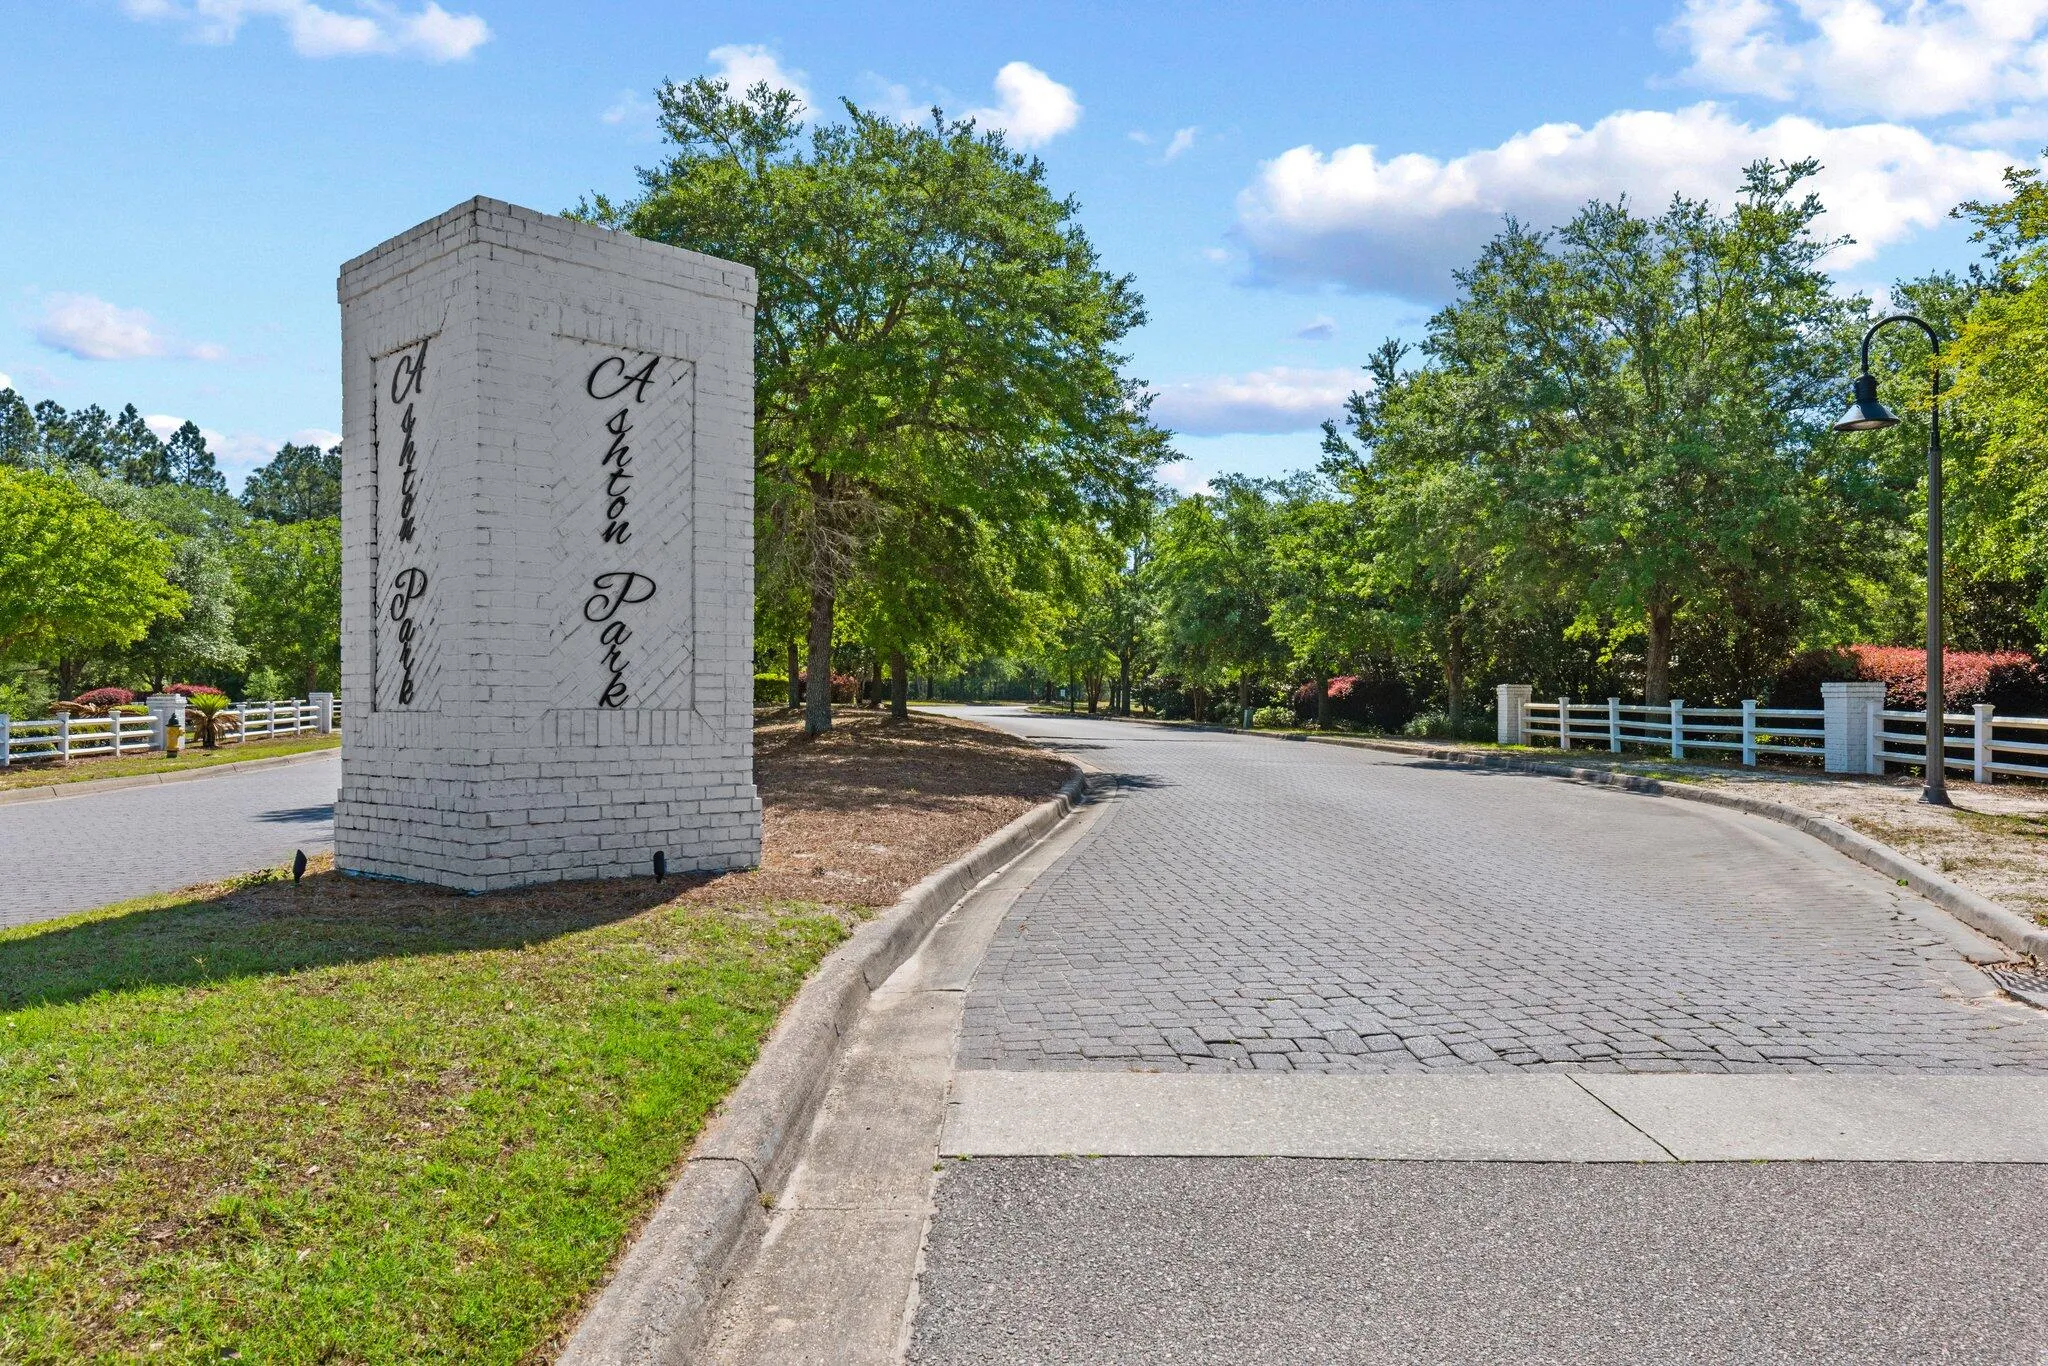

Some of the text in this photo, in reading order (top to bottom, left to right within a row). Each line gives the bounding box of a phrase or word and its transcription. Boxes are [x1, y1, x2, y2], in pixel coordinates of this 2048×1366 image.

[391, 338, 428, 705] Ashton Park
[584, 356, 661, 708] Ashton Park
